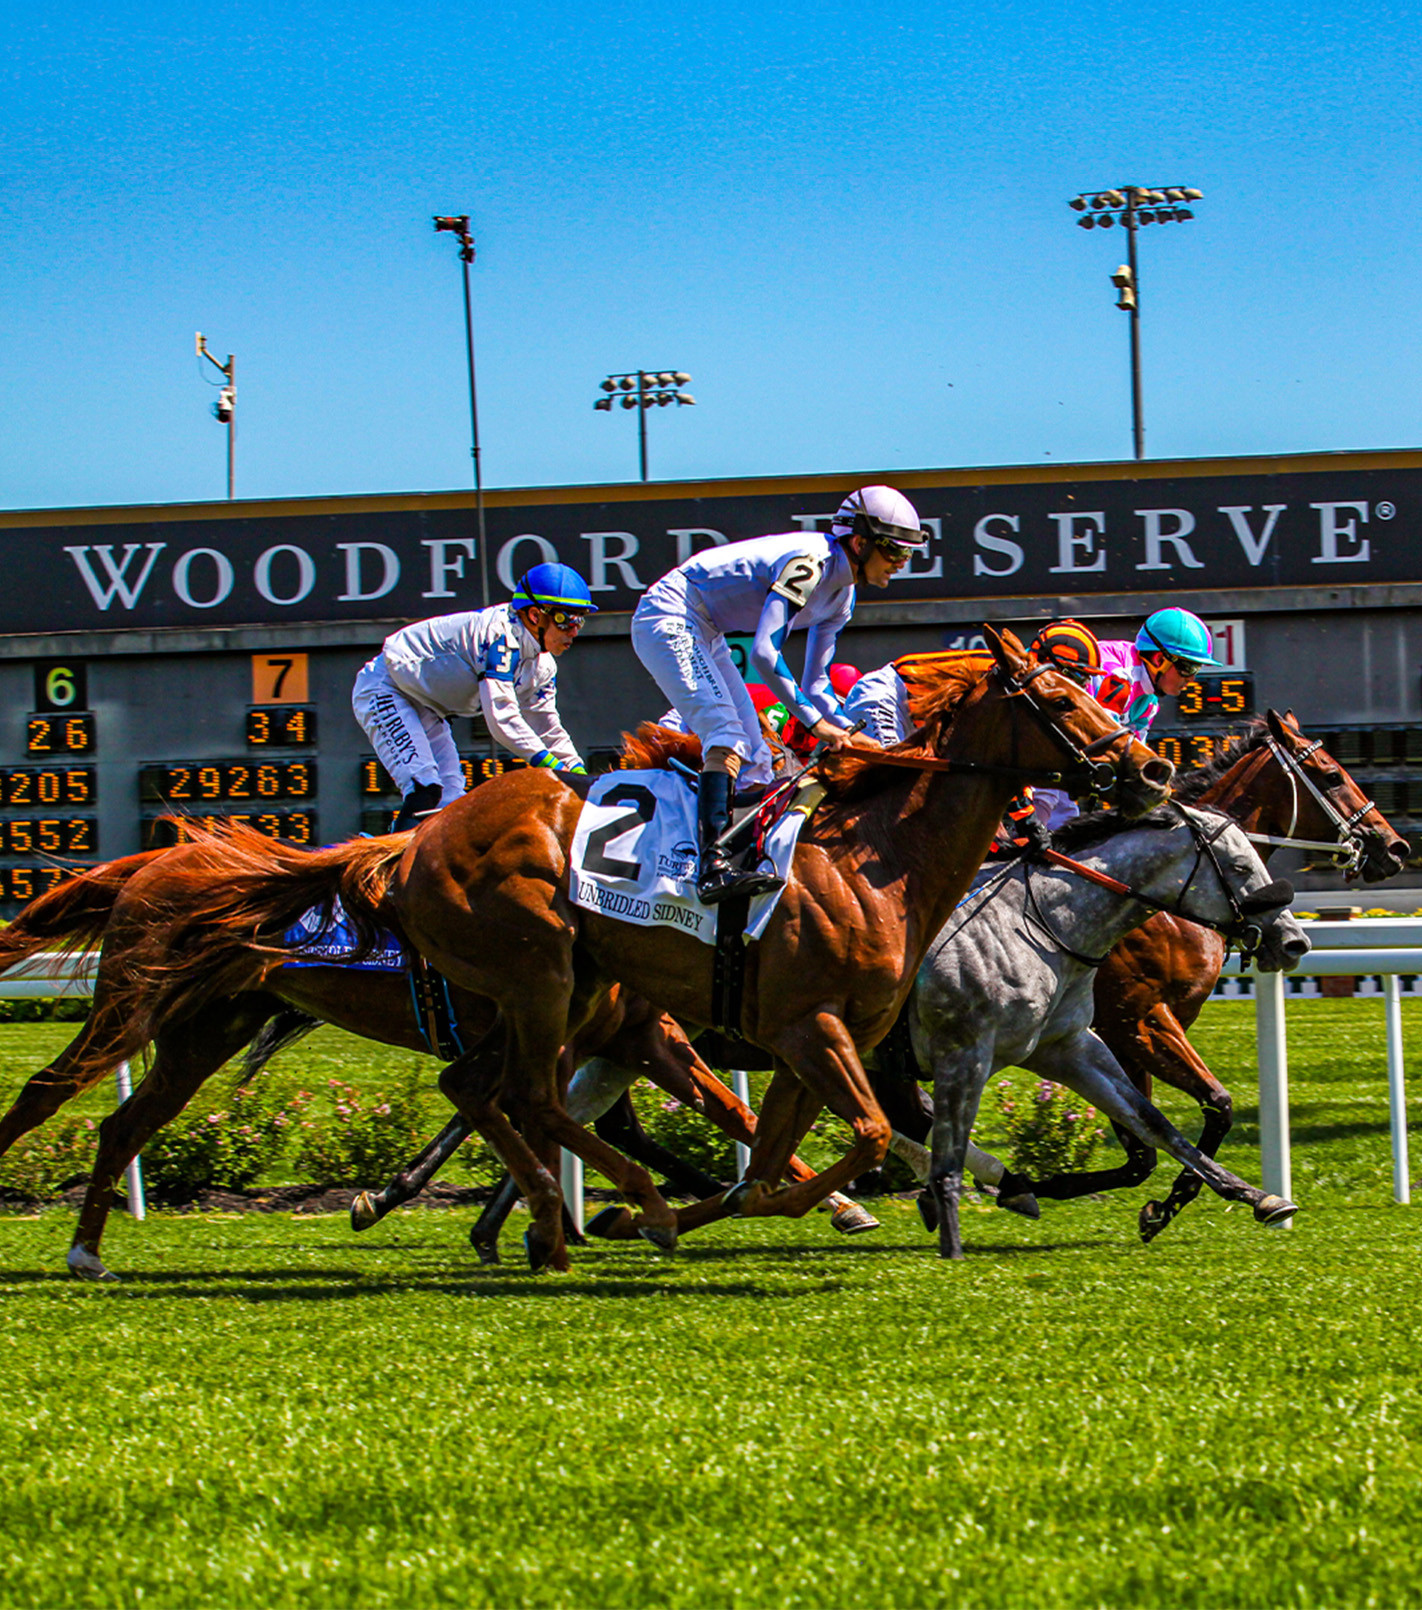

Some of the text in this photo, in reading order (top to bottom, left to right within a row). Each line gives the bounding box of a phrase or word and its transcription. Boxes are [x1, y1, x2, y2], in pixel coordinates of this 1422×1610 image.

[784, 565, 814, 594] 2
[496, 646, 512, 674] 3
[1206, 625, 1235, 667] 1
[46, 667, 76, 706] 6
[267, 659, 293, 698] 7
[1103, 680, 1125, 702] 7
[1180, 680, 1245, 714] 3-5
[0, 771, 88, 803] 205
[169, 764, 308, 798] 29263
[0, 820, 90, 851] 552
[581, 783, 658, 882] 2
[579, 881, 703, 932] UNBRIDLED SIDNEY
